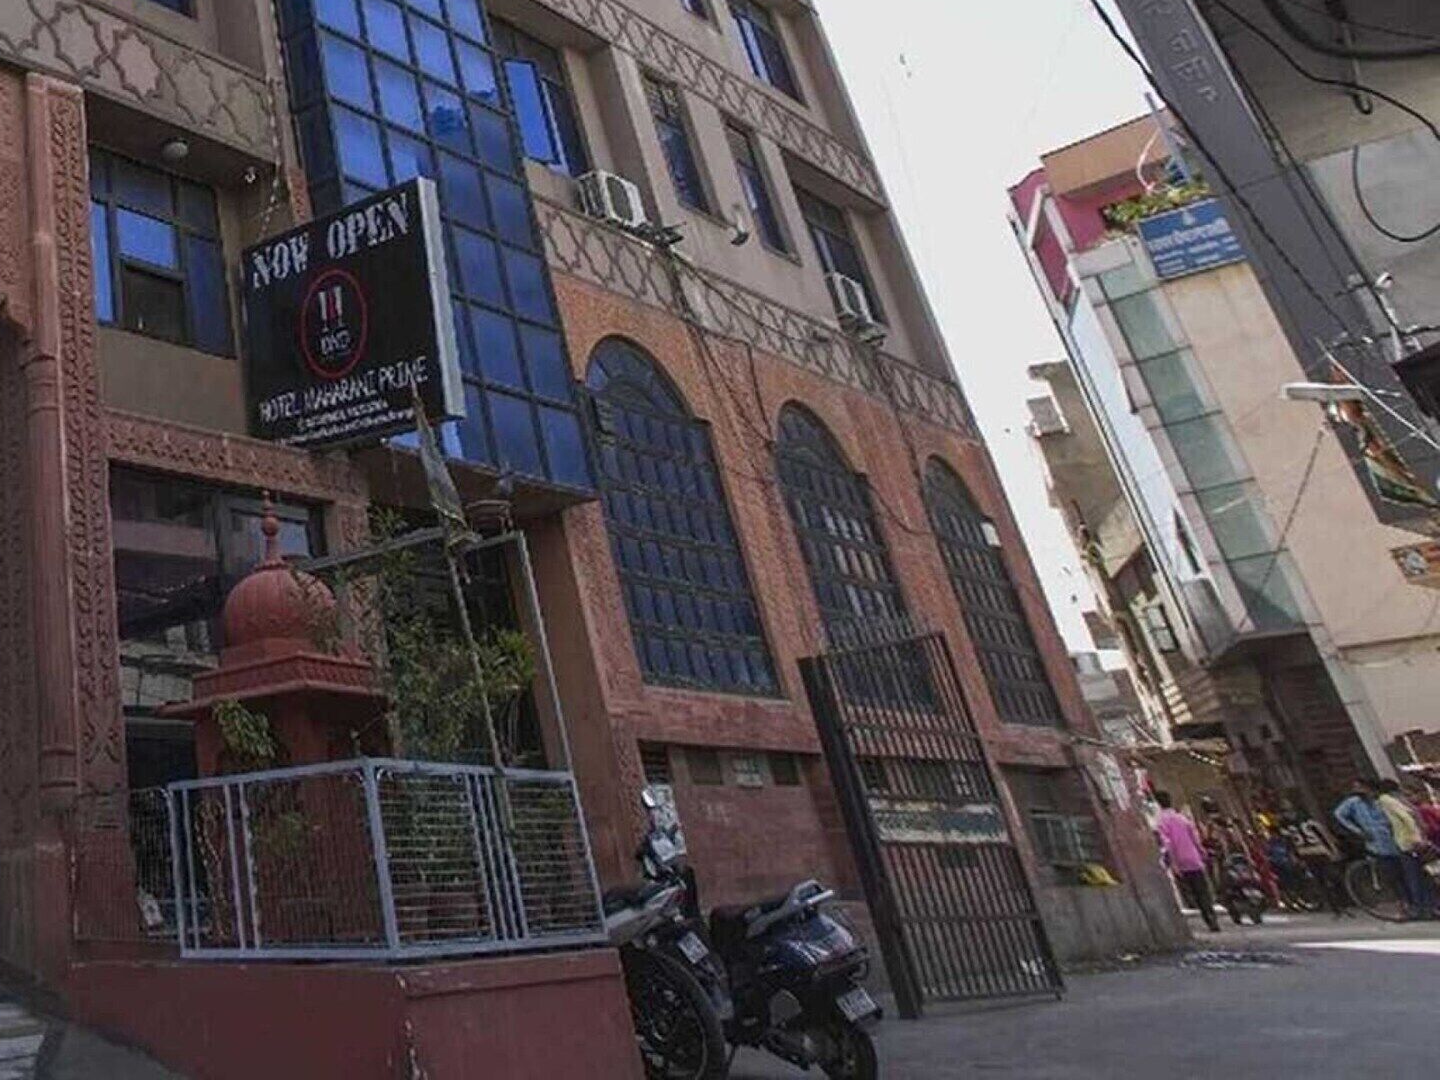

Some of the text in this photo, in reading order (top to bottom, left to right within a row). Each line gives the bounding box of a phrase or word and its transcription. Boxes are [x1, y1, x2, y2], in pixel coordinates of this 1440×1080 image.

[252, 192, 408, 288] NOW OPEN
[259, 392, 301, 422] HOTEL
